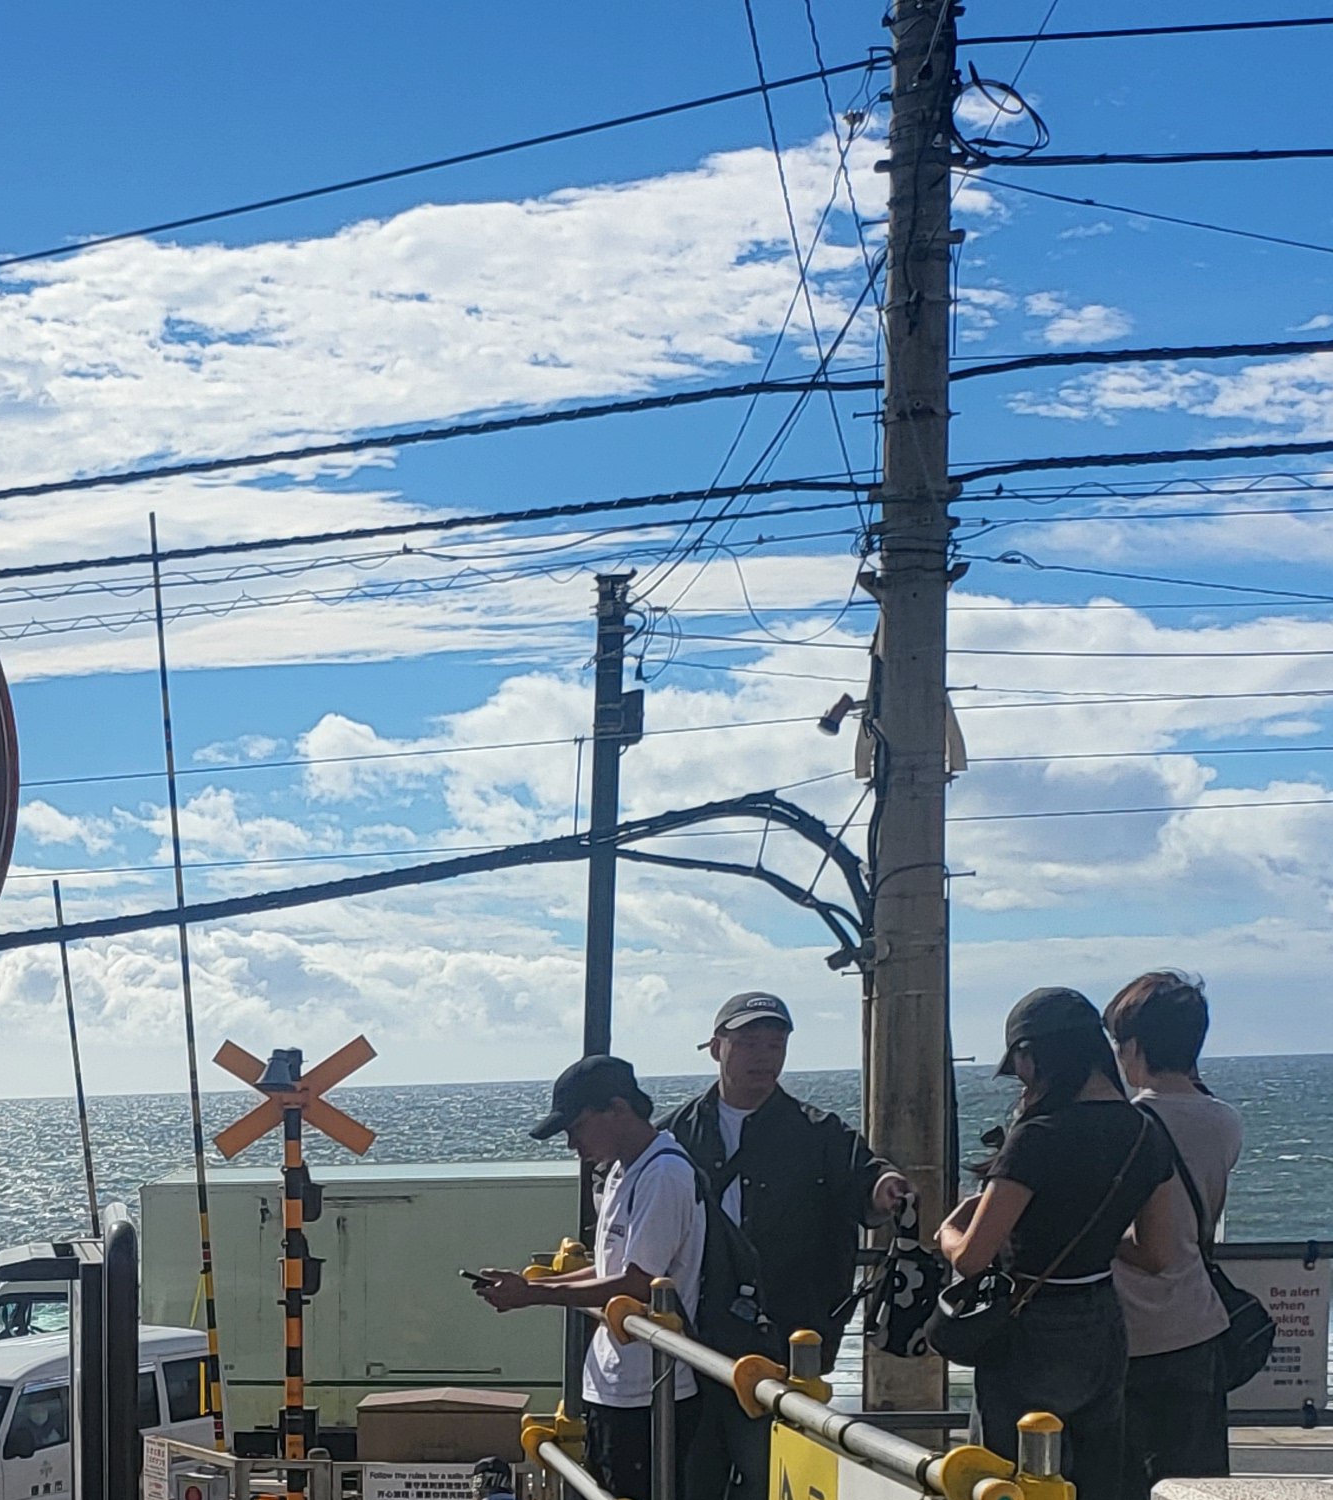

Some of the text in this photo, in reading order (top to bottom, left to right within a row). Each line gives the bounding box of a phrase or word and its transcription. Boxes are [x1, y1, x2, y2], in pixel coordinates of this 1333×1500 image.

[1270, 1286, 1320, 1297] Be alert
[1269, 1301, 1305, 1311] when
[1275, 1314, 1310, 1326] aking
[1277, 1328, 1315, 1338] hotos
[369, 1471, 393, 1480] Follow
[394, 1471, 407, 1480] the
[408, 1471, 427, 1480] rules
[428, 1471, 440, 1480] for
